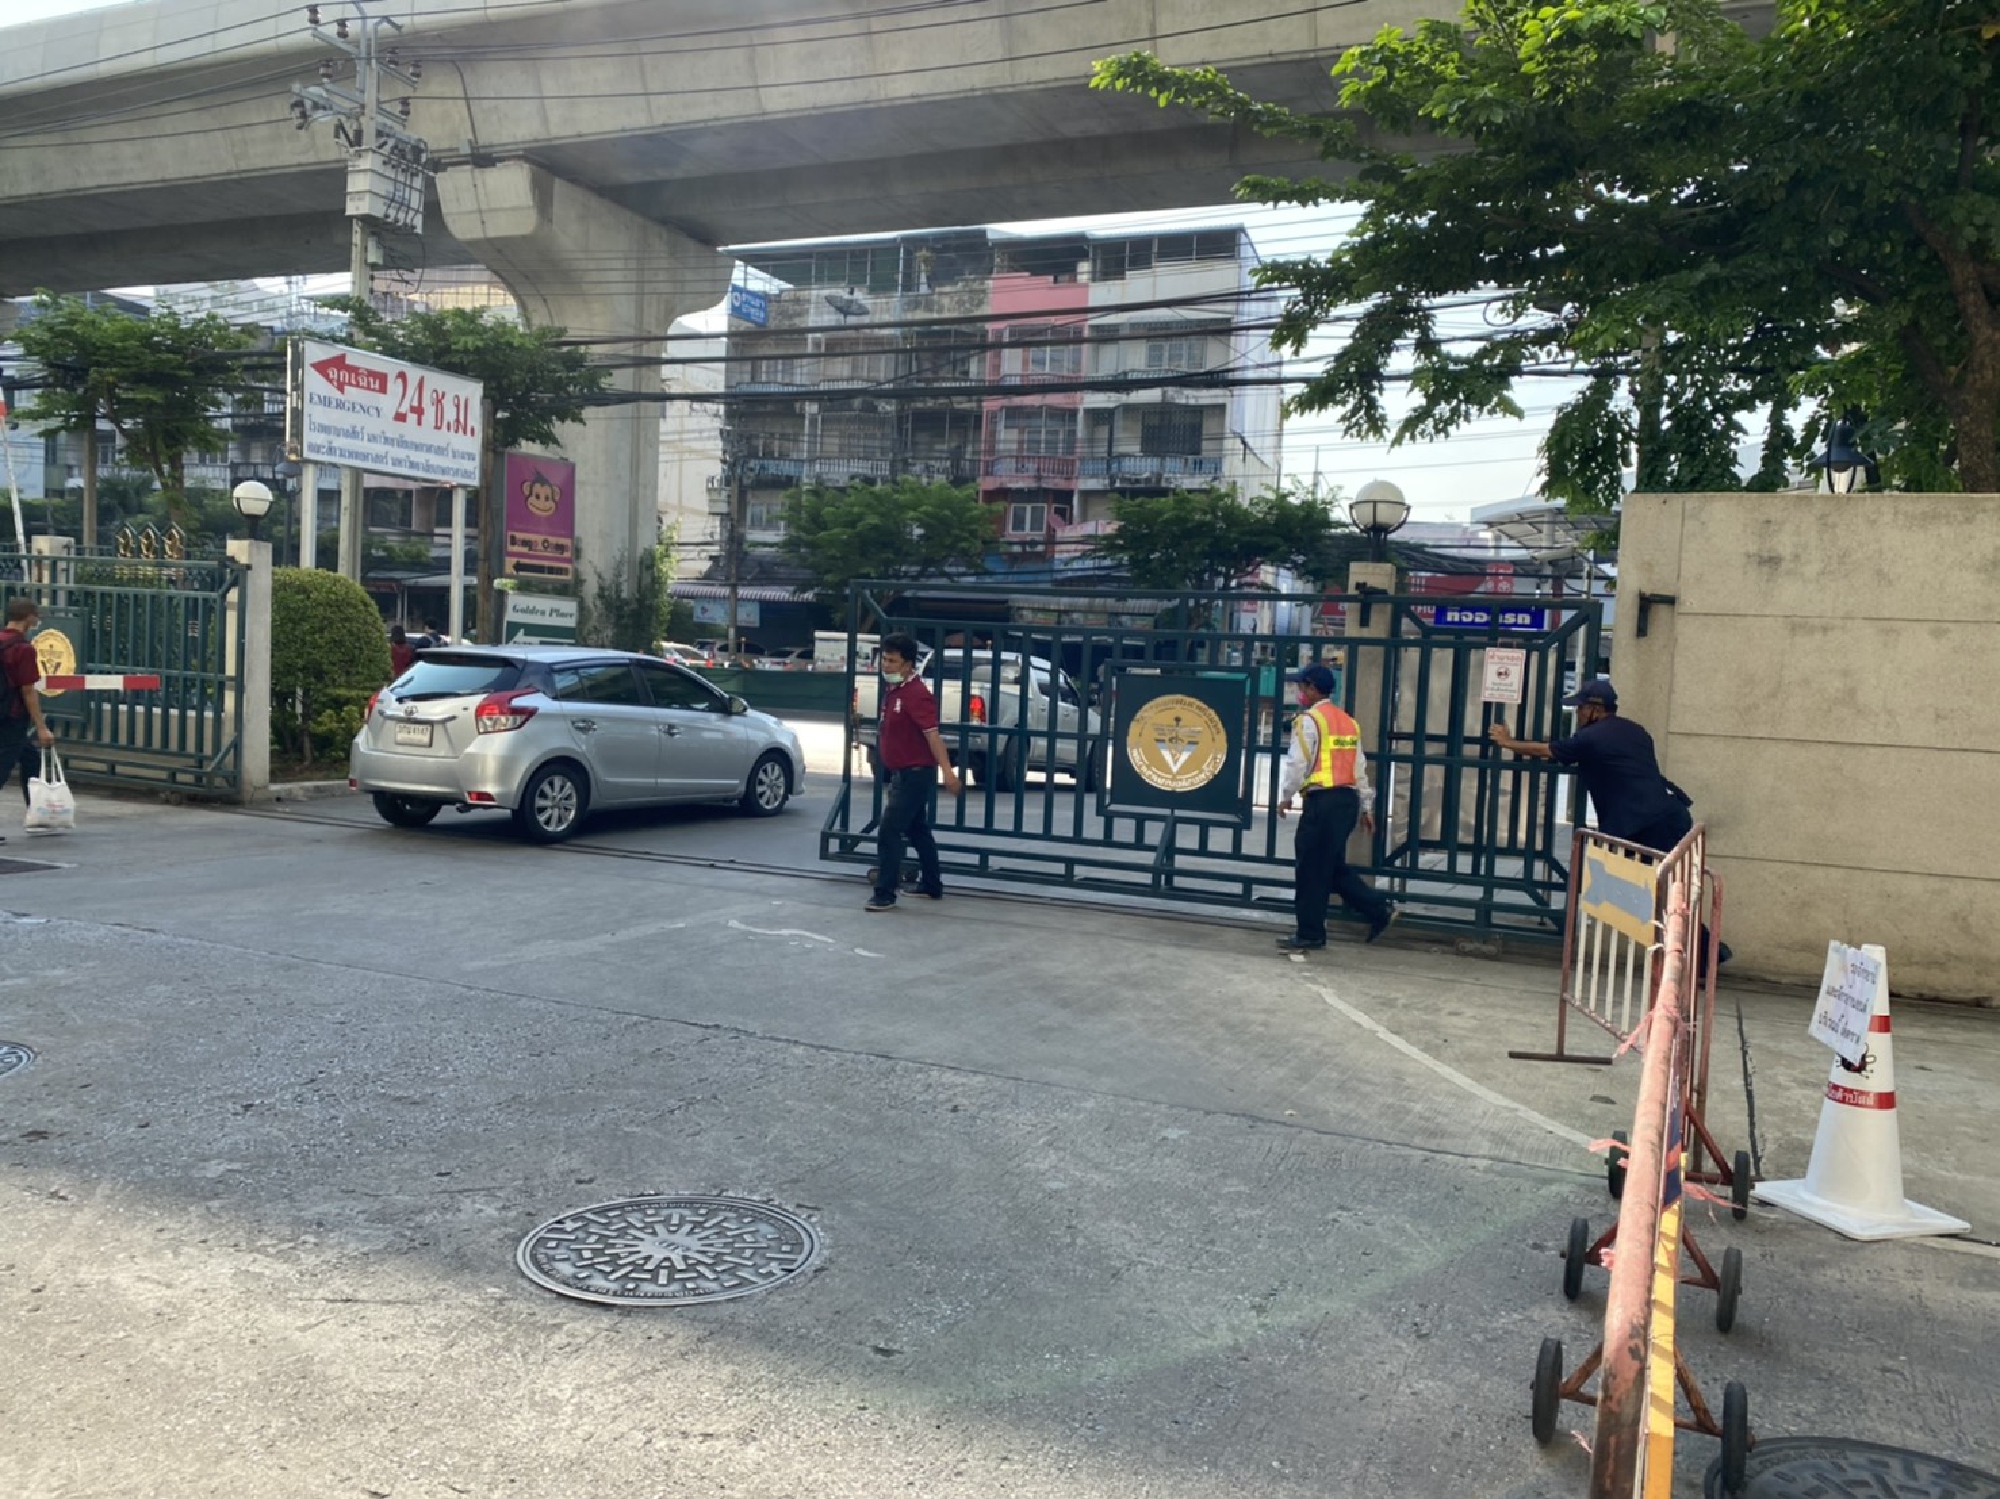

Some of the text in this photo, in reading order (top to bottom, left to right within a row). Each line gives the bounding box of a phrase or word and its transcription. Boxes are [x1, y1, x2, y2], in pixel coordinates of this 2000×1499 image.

[326, 366, 381, 391] ฉุกเฉิน
[308, 391, 382, 418] EMERGENCY
[392, 370, 476, 438] 24 ช.ม.
[512, 603, 546, 617] Golden
